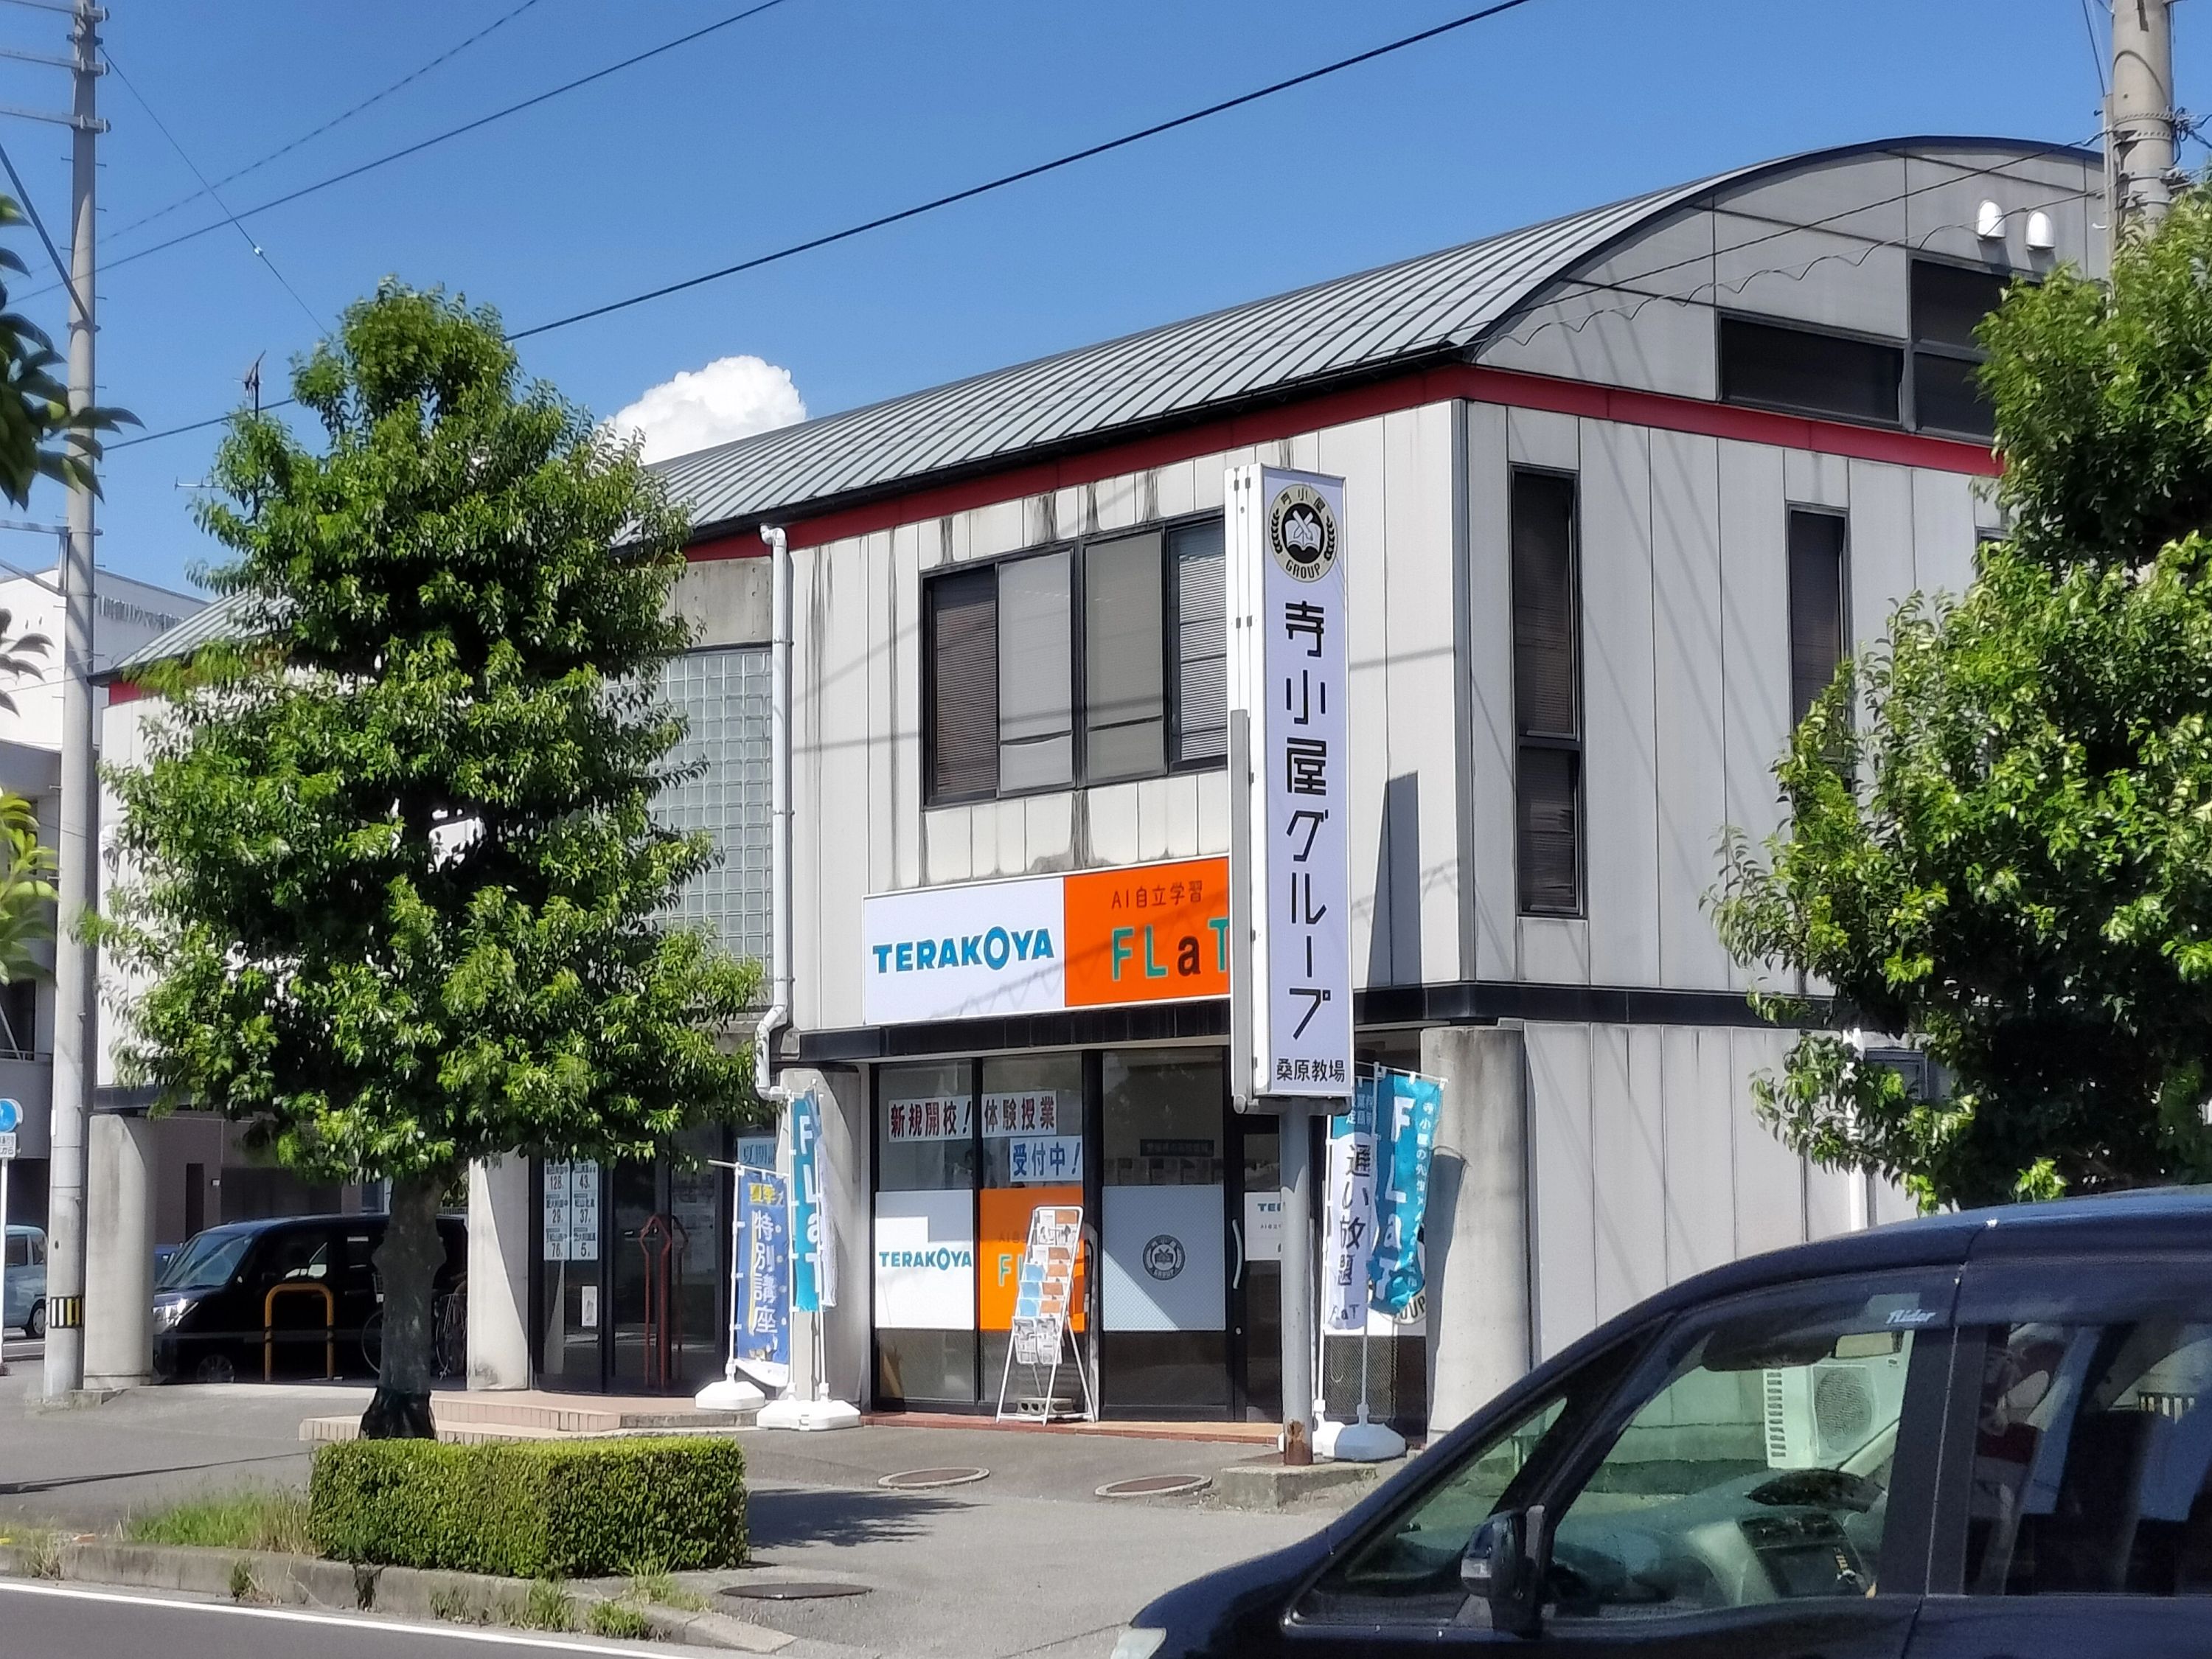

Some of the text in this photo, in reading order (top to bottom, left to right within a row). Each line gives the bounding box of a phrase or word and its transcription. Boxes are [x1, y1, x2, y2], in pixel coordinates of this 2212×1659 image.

[1285, 558, 1321, 579] GROUP
[1285, 600, 1331, 1041] 寺小屋グループ
[1112, 880, 1203, 910] AI自立学習
[872, 925, 1055, 973] TERAKOYA
[1111, 917, 1229, 981] FLaT
[1276, 1058, 1346, 1082] 桑原教場
[891, 1100, 972, 1138] 新規開校!
[984, 1096, 1054, 1133] 体験授業
[1013, 1141, 1081, 1178] 受付中!
[754, 1210, 778, 1334] 特別講座
[878, 1247, 973, 1271] TERAKOYA
